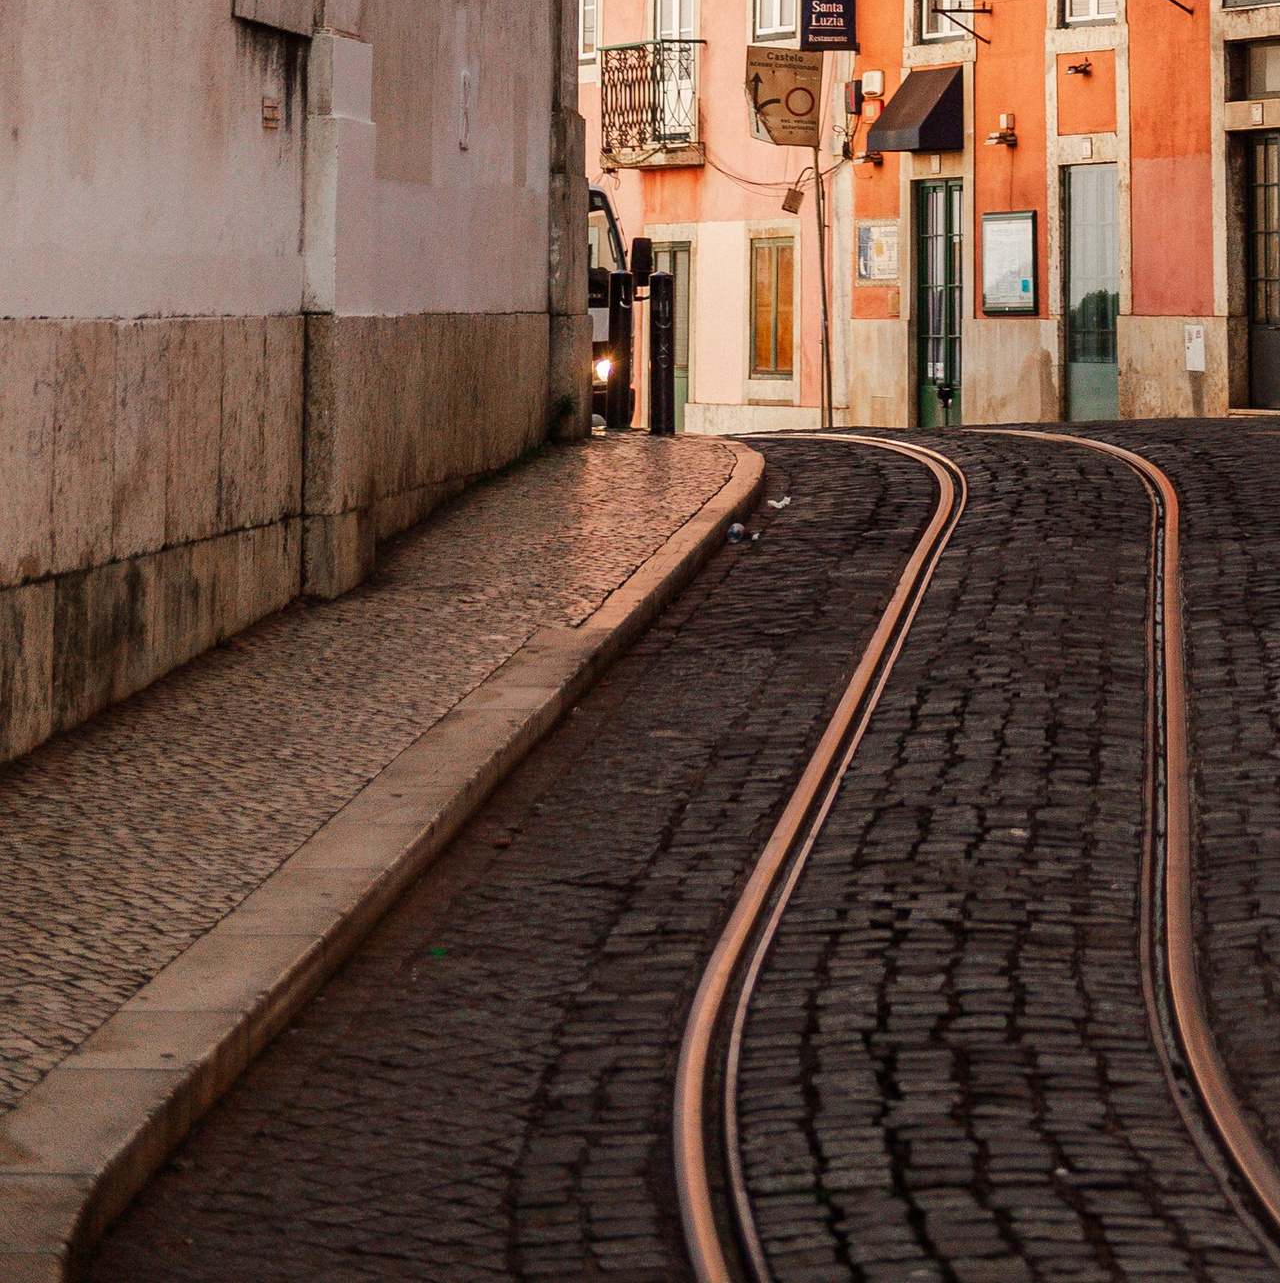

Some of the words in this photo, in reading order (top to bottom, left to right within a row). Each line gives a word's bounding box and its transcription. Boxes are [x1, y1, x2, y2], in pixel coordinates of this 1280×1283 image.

[811, 0, 843, 13] Santa
[811, 14, 844, 26] Luzia
[808, 34, 848, 42] Restaurante
[766, 51, 804, 63] Castelo
